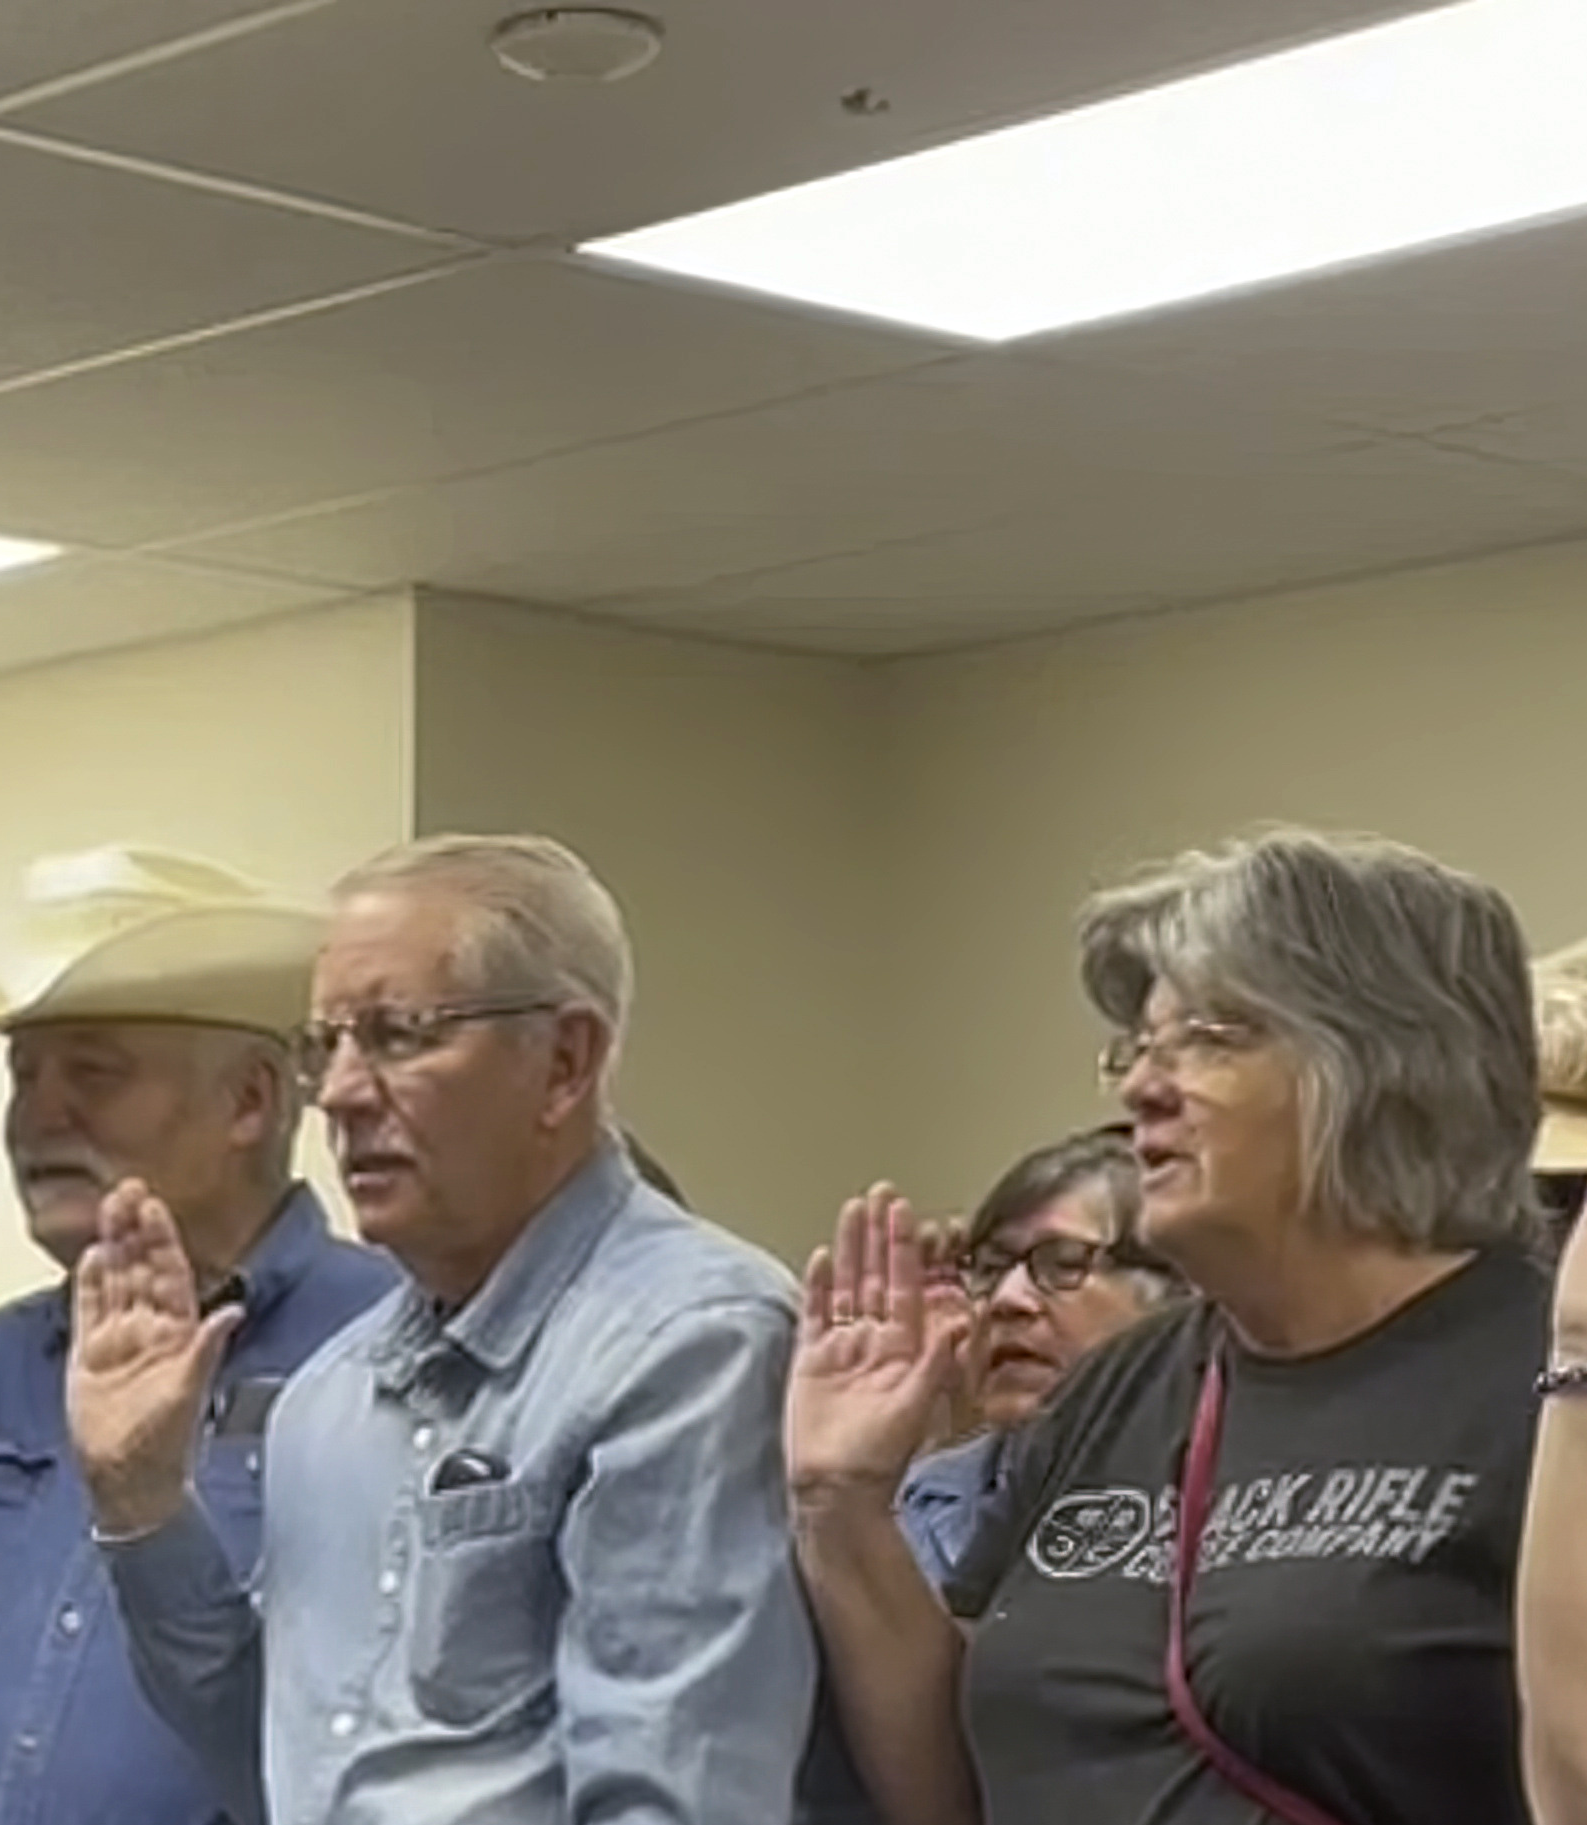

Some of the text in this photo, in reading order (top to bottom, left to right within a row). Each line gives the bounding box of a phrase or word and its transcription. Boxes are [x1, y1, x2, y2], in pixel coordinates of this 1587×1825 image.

[1154, 1467, 1478, 1539] BACK RIFLE
[1244, 1518, 1450, 1564] COMPANY
